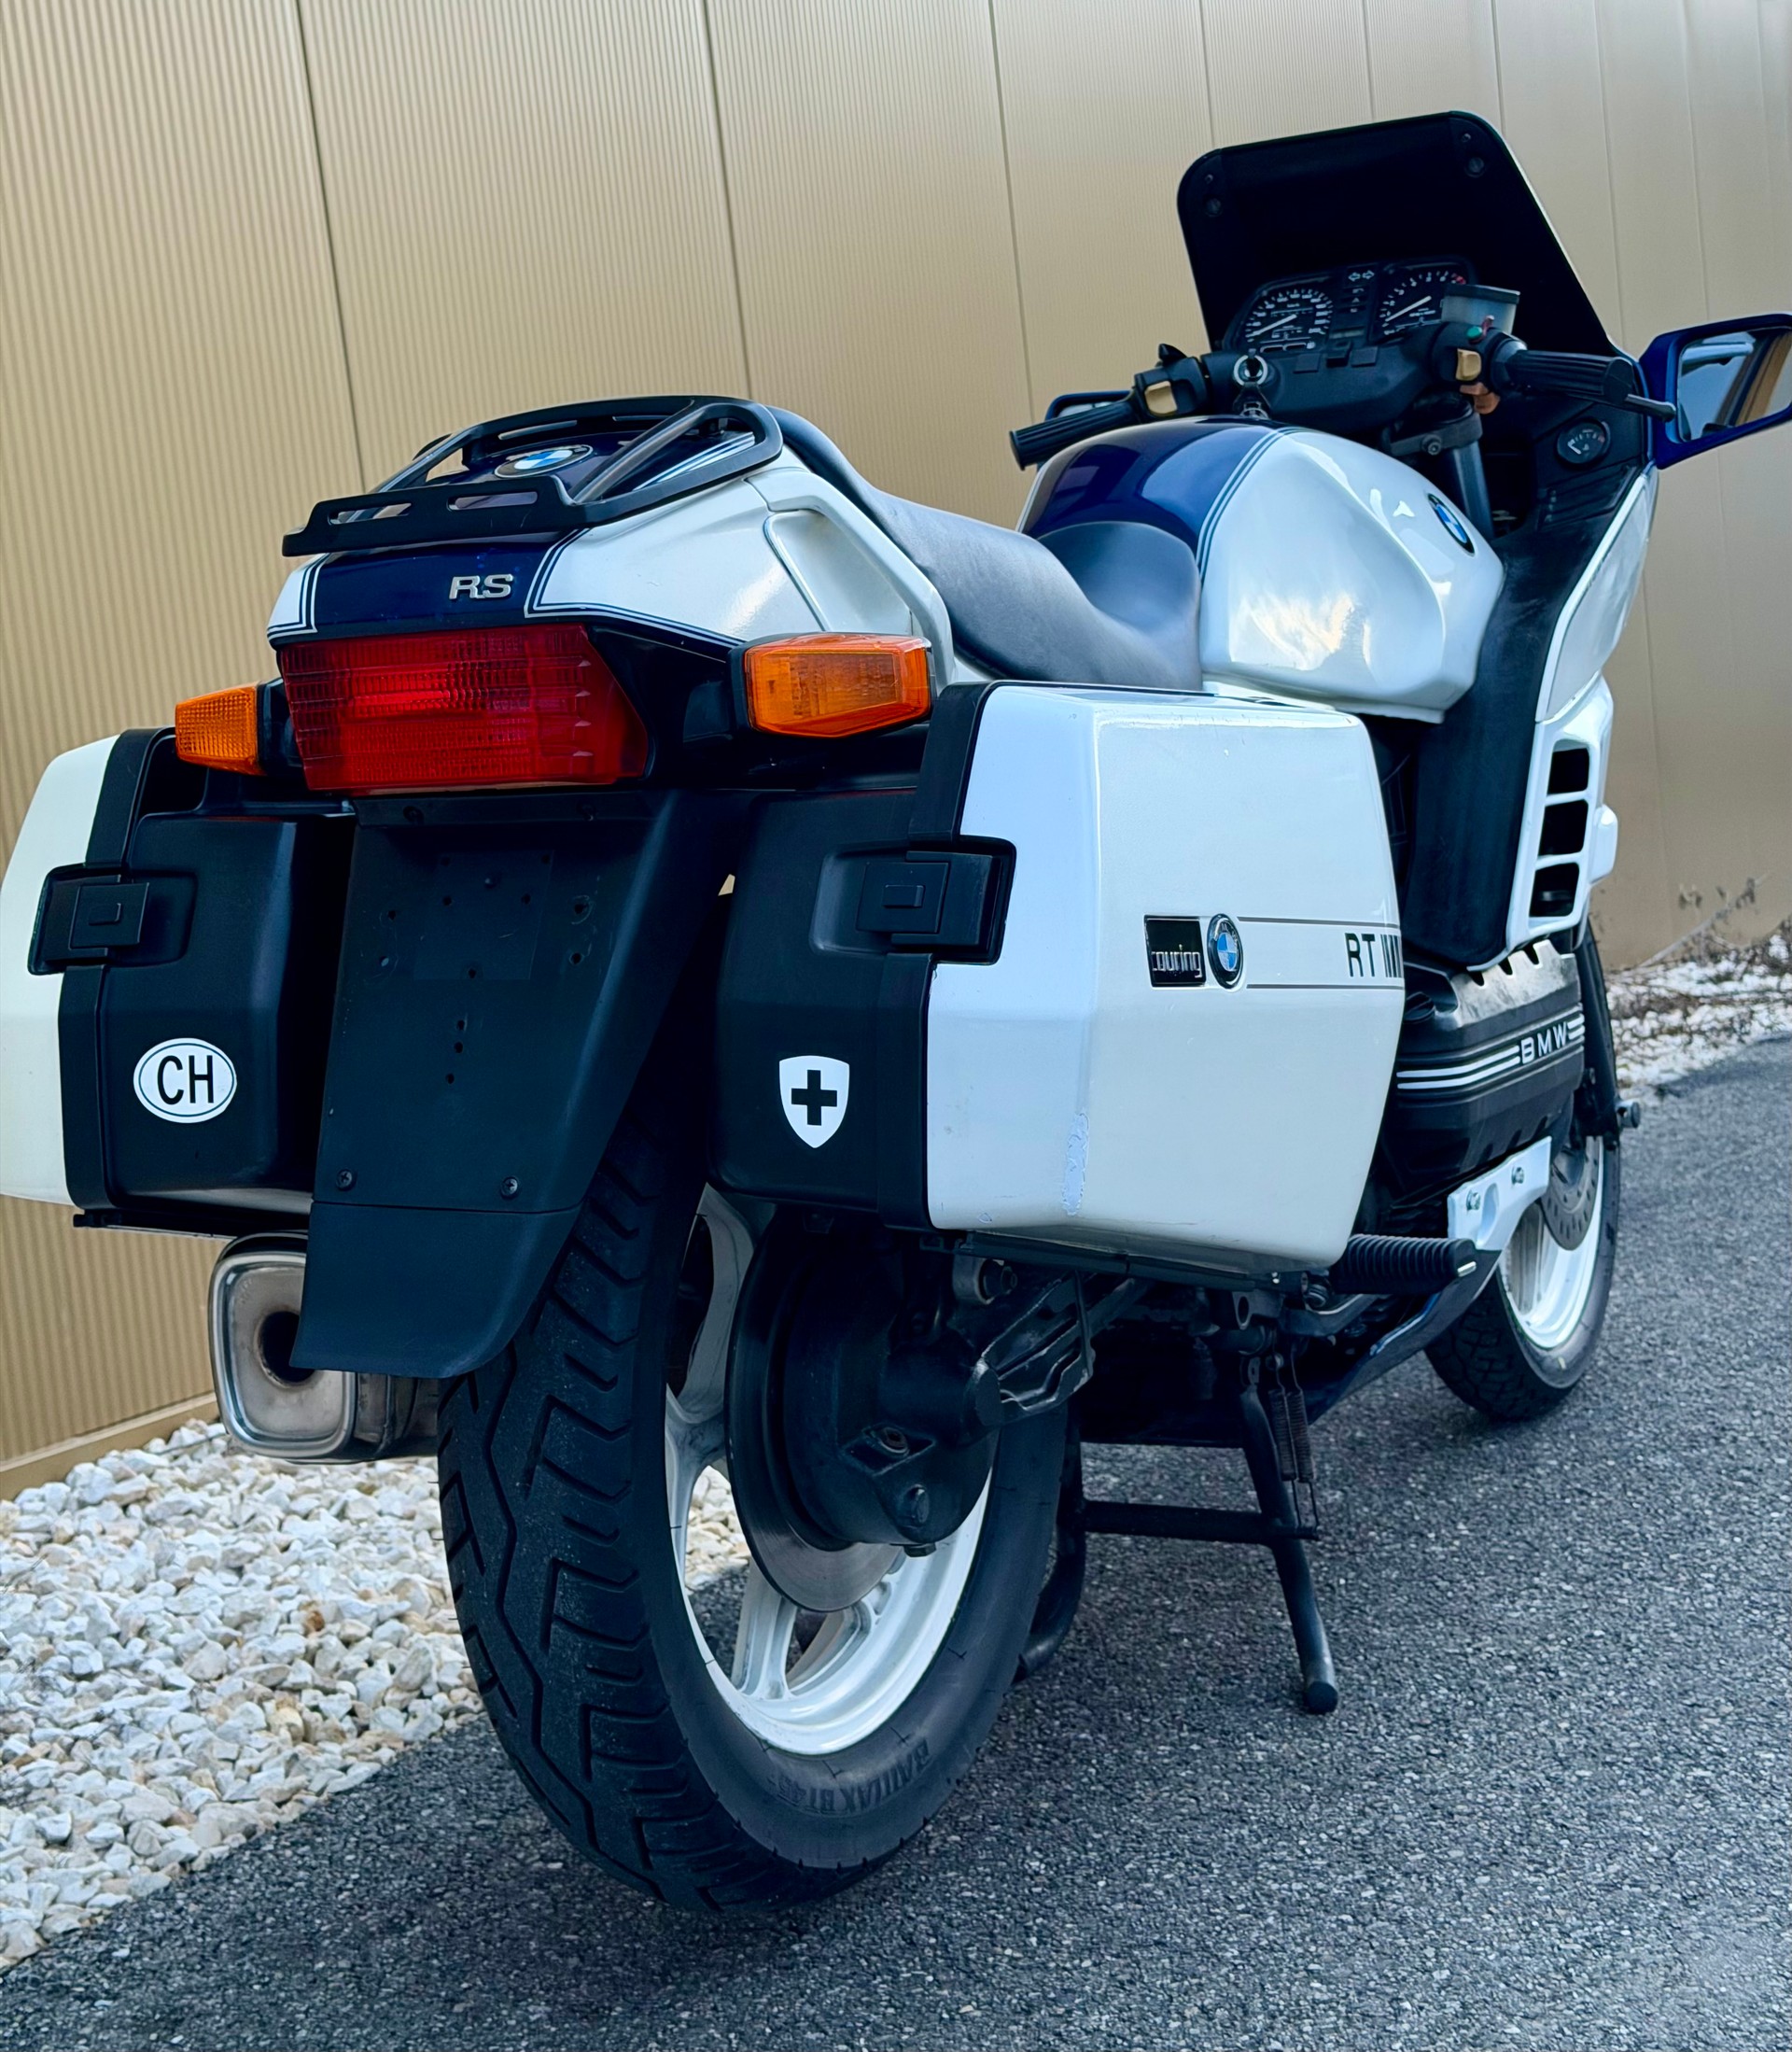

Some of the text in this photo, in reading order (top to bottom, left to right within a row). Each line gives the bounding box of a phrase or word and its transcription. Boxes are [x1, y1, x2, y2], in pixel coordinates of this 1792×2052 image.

[449, 573, 513, 600] RS
[1344, 932, 1376, 977] RT
[1520, 1020, 1568, 1064] BMW
[157, 1055, 215, 1105] CH
